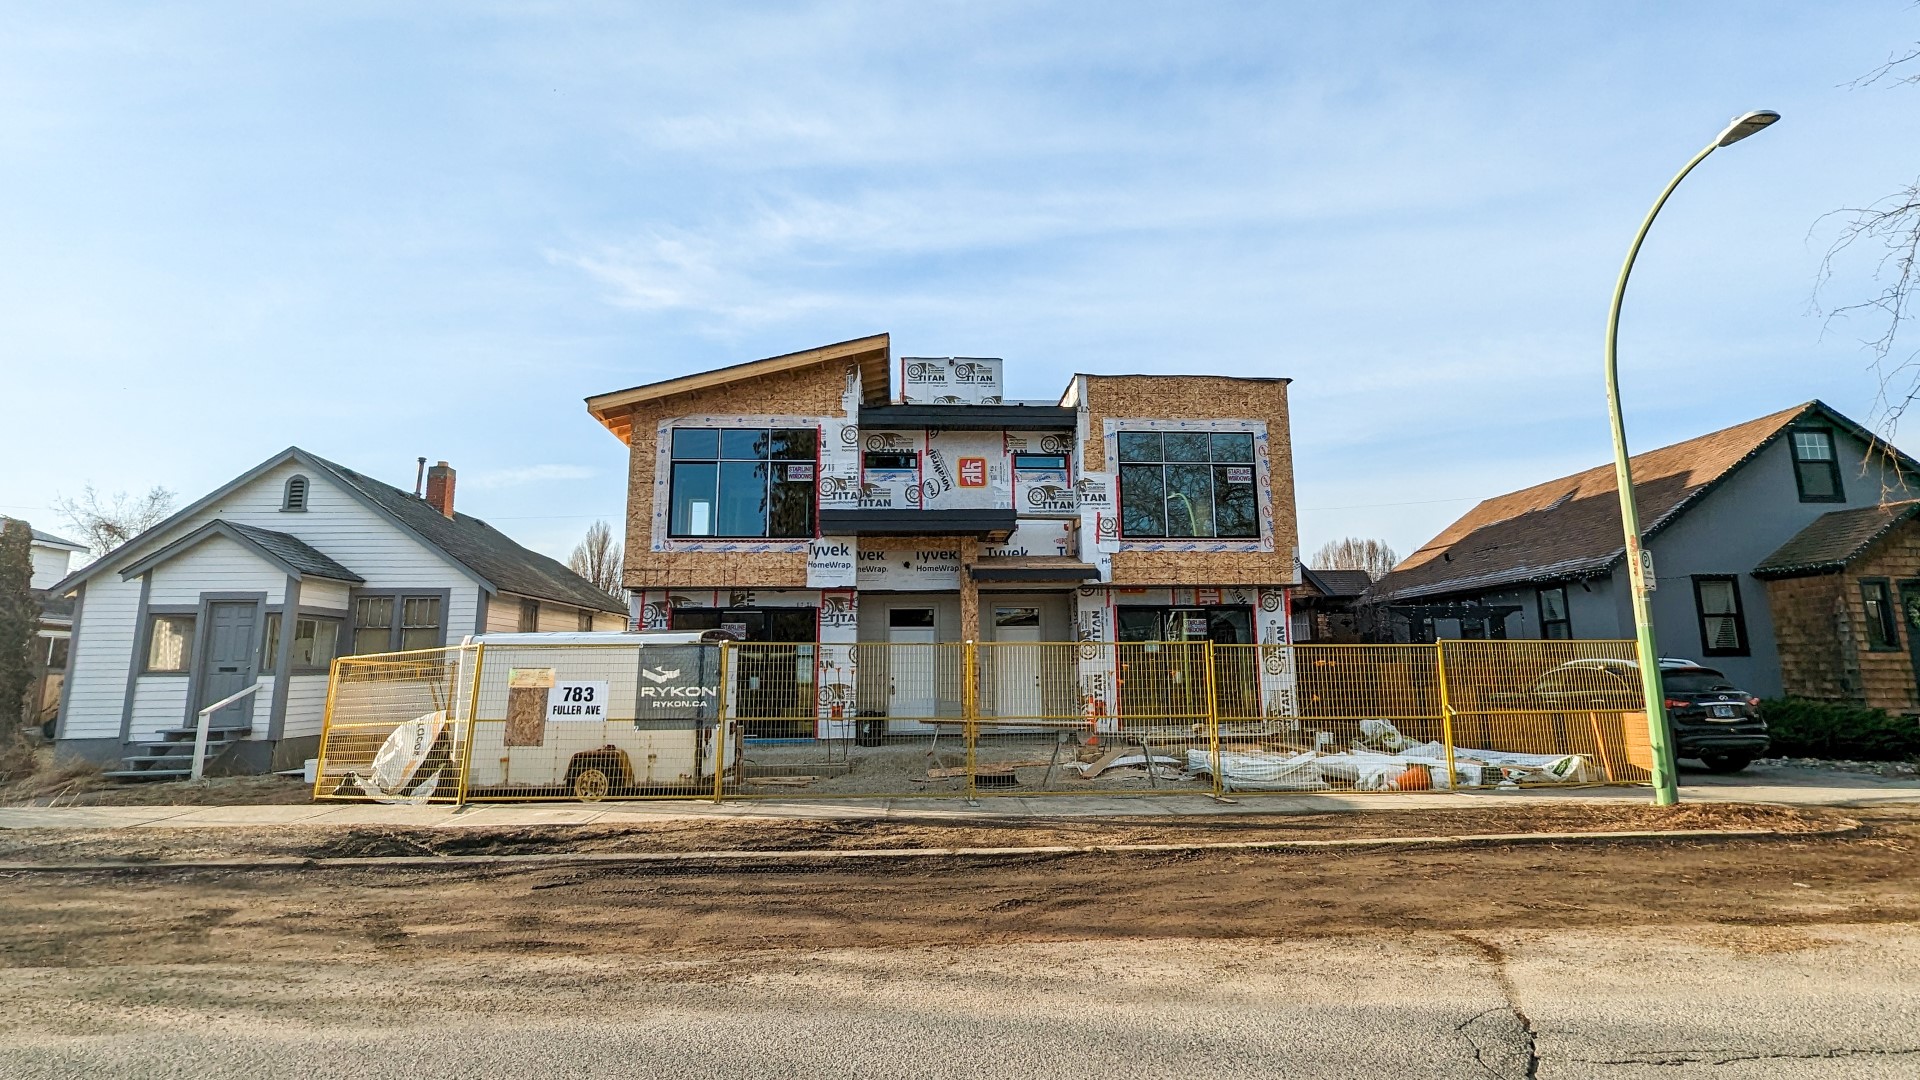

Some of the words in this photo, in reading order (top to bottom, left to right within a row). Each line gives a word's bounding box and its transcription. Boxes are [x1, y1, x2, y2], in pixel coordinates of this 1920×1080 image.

[919, 374, 945, 382] TITAN
[966, 374, 993, 382] TITAN
[929, 448, 952, 492] NovaWrap
[926, 480, 937, 497] Tuck
[858, 499, 892, 507] TITAN
[1041, 501, 1075, 510] TITAN
[808, 543, 848, 559] Tyvek
[916, 551, 957, 563] Tyvek
[808, 561, 851, 569] HomeWrap
[917, 565, 959, 573] HomeWrap
[563, 686, 595, 702] 783
[641, 685, 717, 698] RYKON
[652, 700, 708, 708] RYKON.CA
[552, 705, 582, 715] FULLER
[585, 705, 601, 715] AVE
